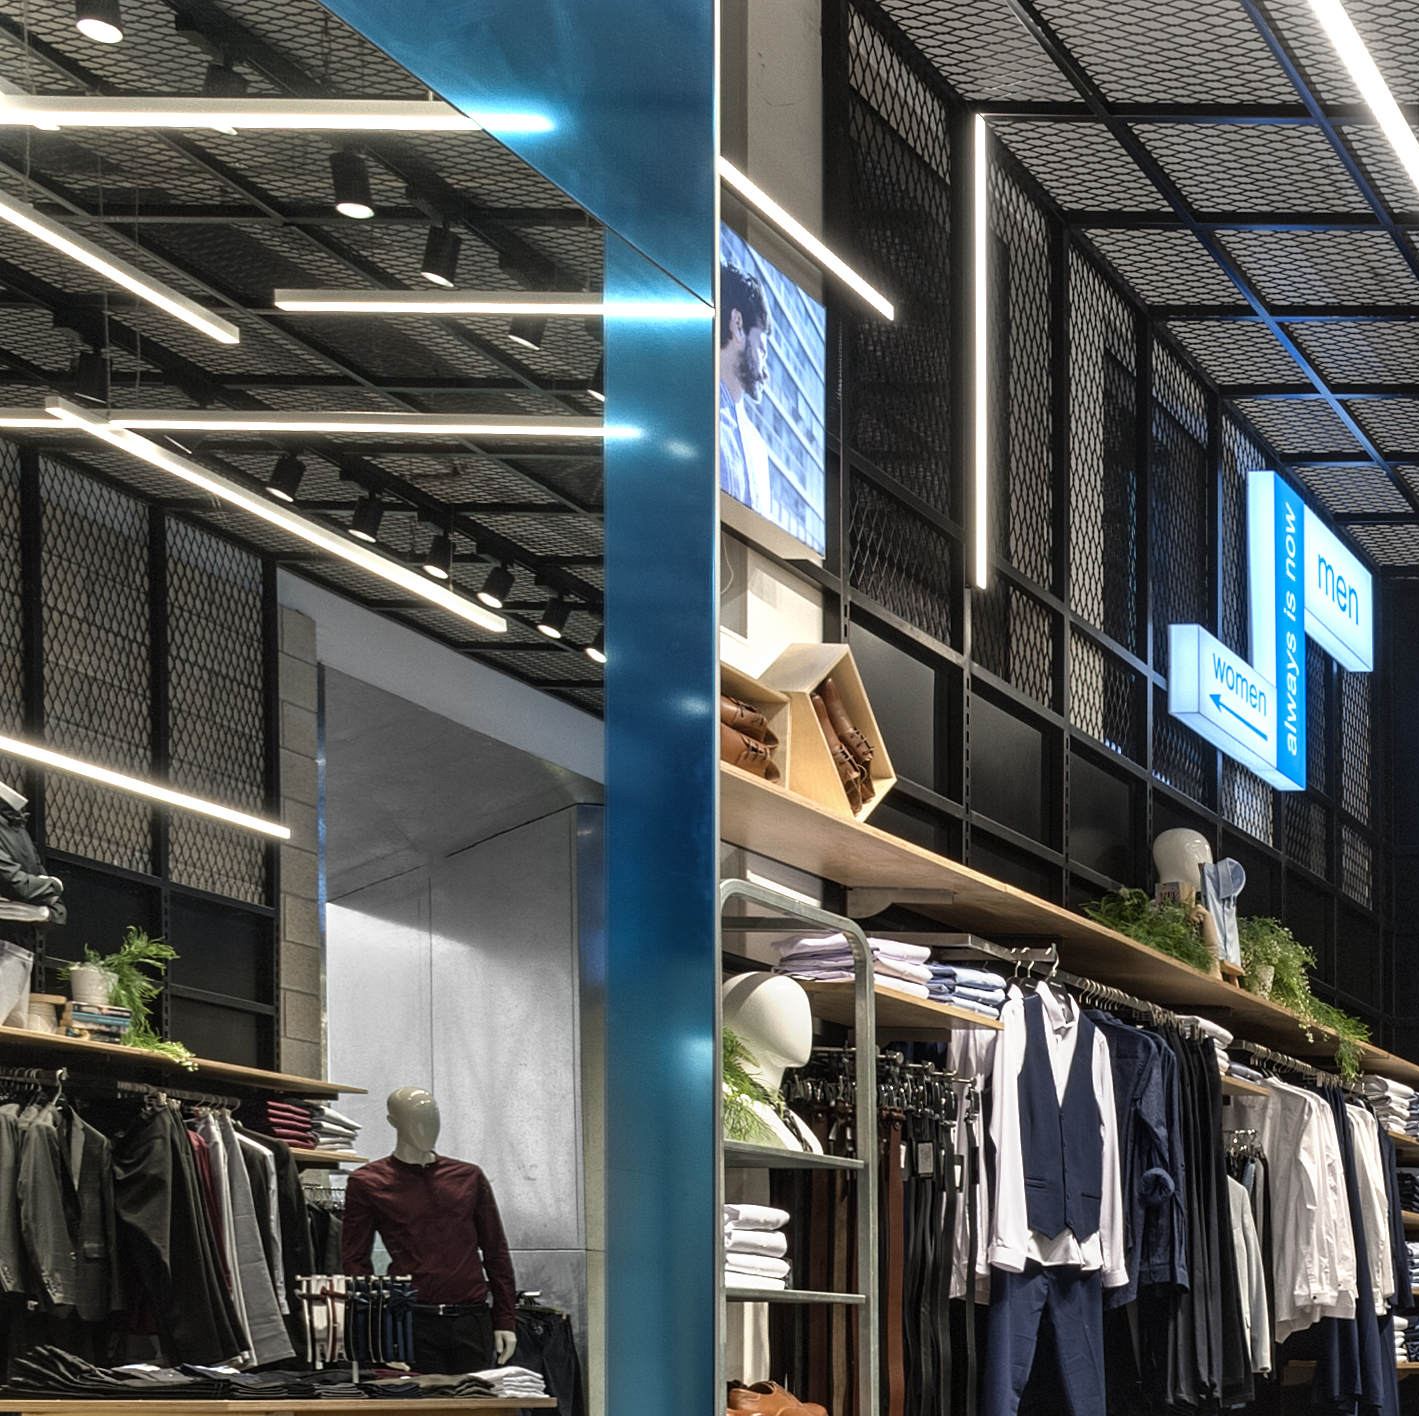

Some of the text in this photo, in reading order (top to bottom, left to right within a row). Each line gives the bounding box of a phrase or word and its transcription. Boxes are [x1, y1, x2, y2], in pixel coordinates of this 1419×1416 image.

[1317, 553, 1360, 626] men
[1284, 502, 1299, 757] always is now
[1212, 652, 1268, 717] women
